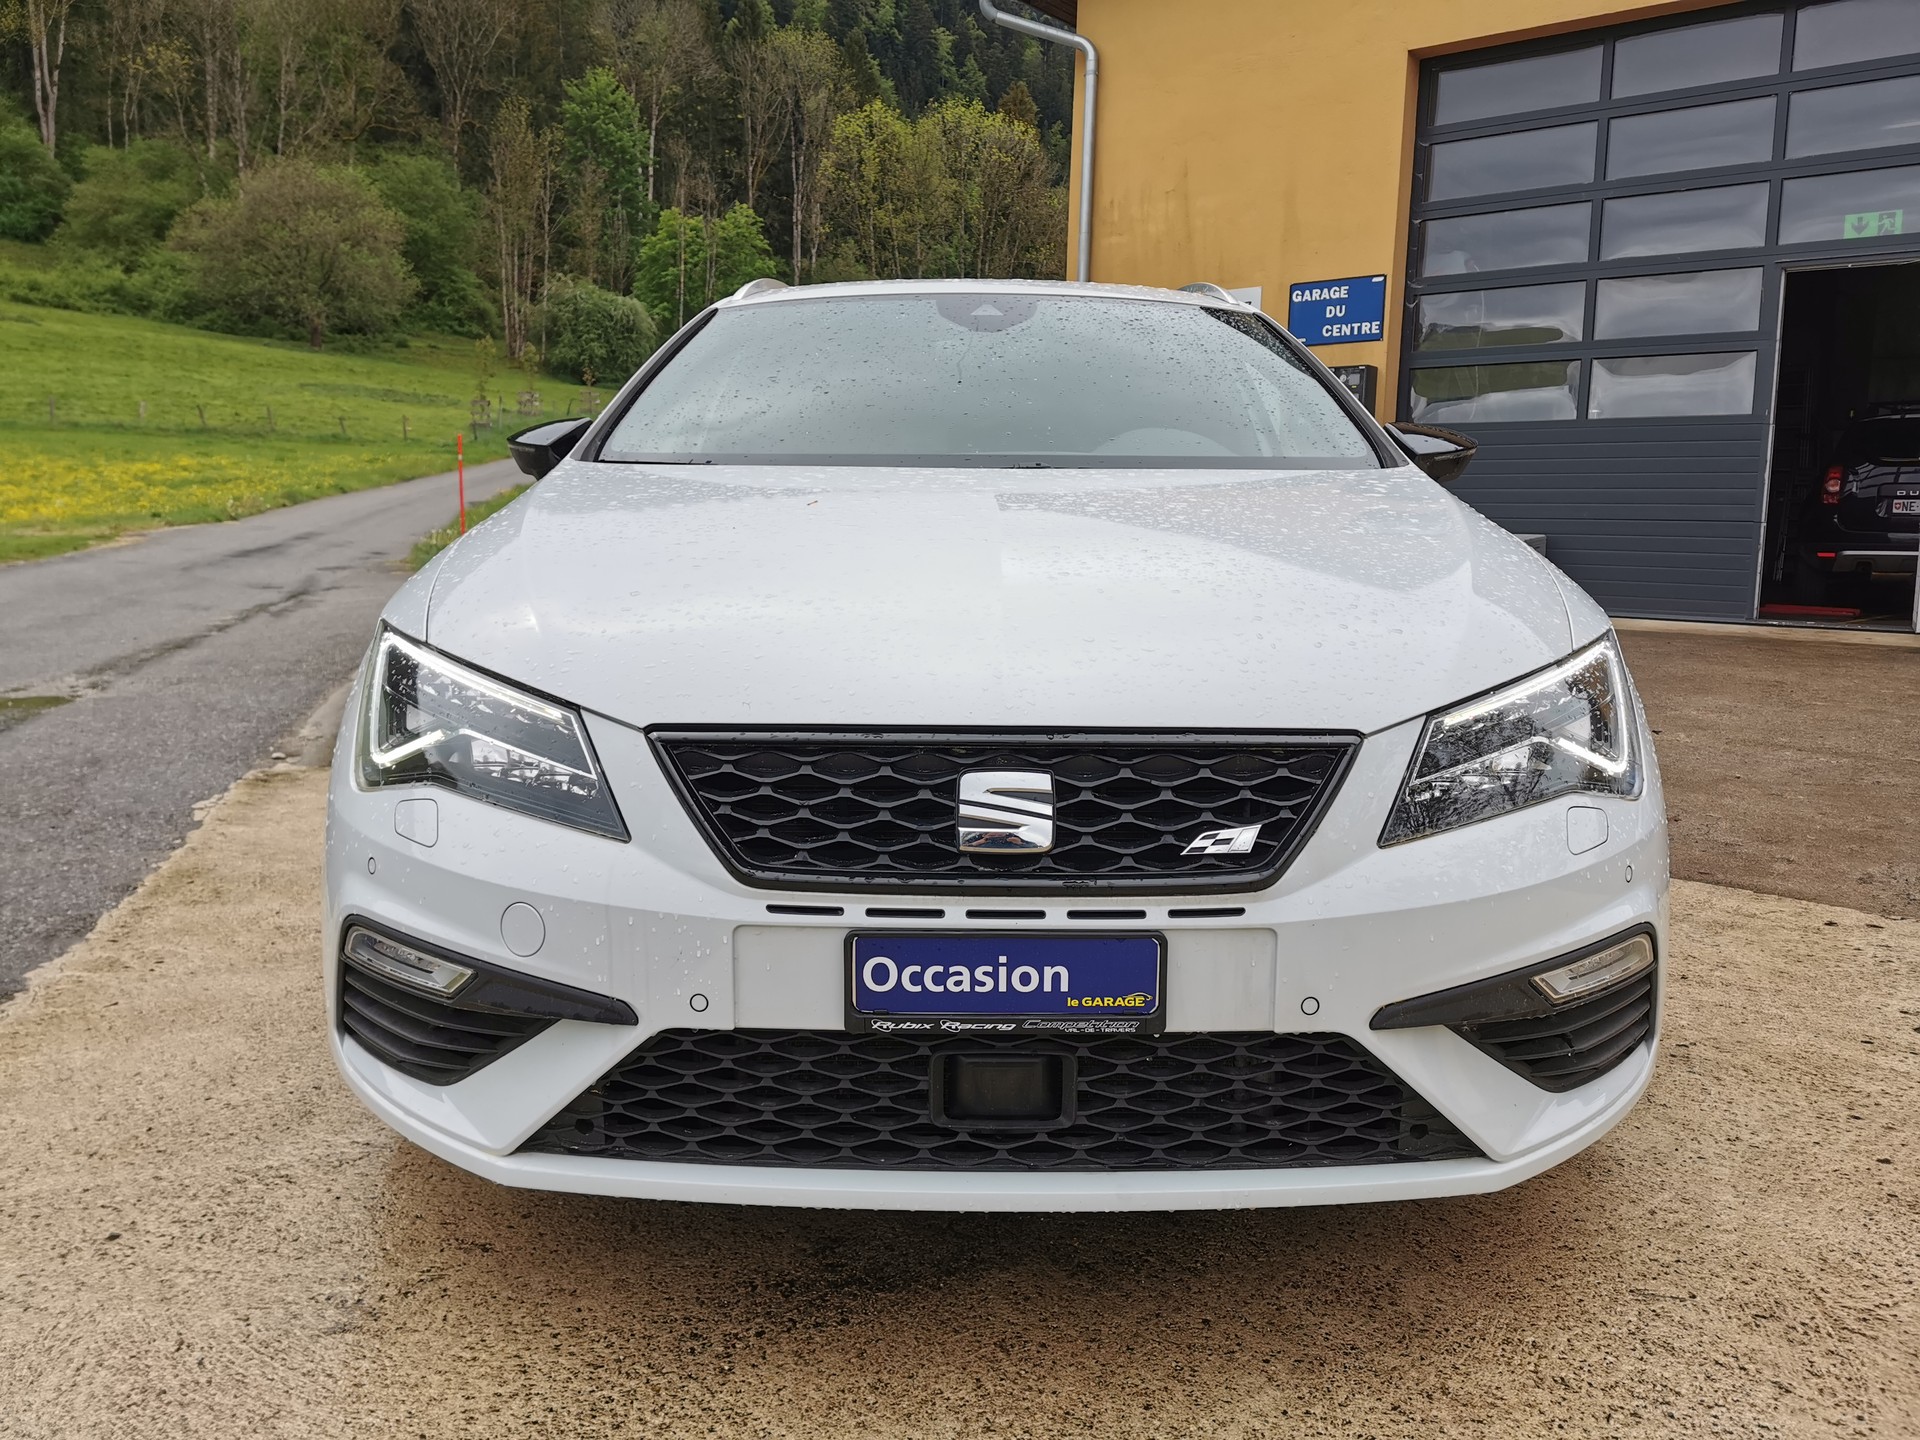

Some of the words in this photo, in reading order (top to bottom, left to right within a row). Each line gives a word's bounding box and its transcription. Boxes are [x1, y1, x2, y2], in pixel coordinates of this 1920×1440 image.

[1292, 286, 1349, 303] GARAGE
[1325, 305, 1346, 318] DU
[1322, 321, 1380, 337] CENTRE
[862, 955, 1069, 993] Occasion
[1067, 997, 1079, 1007] le
[1082, 997, 1146, 1007] GARAGE
[871, 1019, 935, 1033] Rubix
[940, 1019, 1017, 1033] Racing
